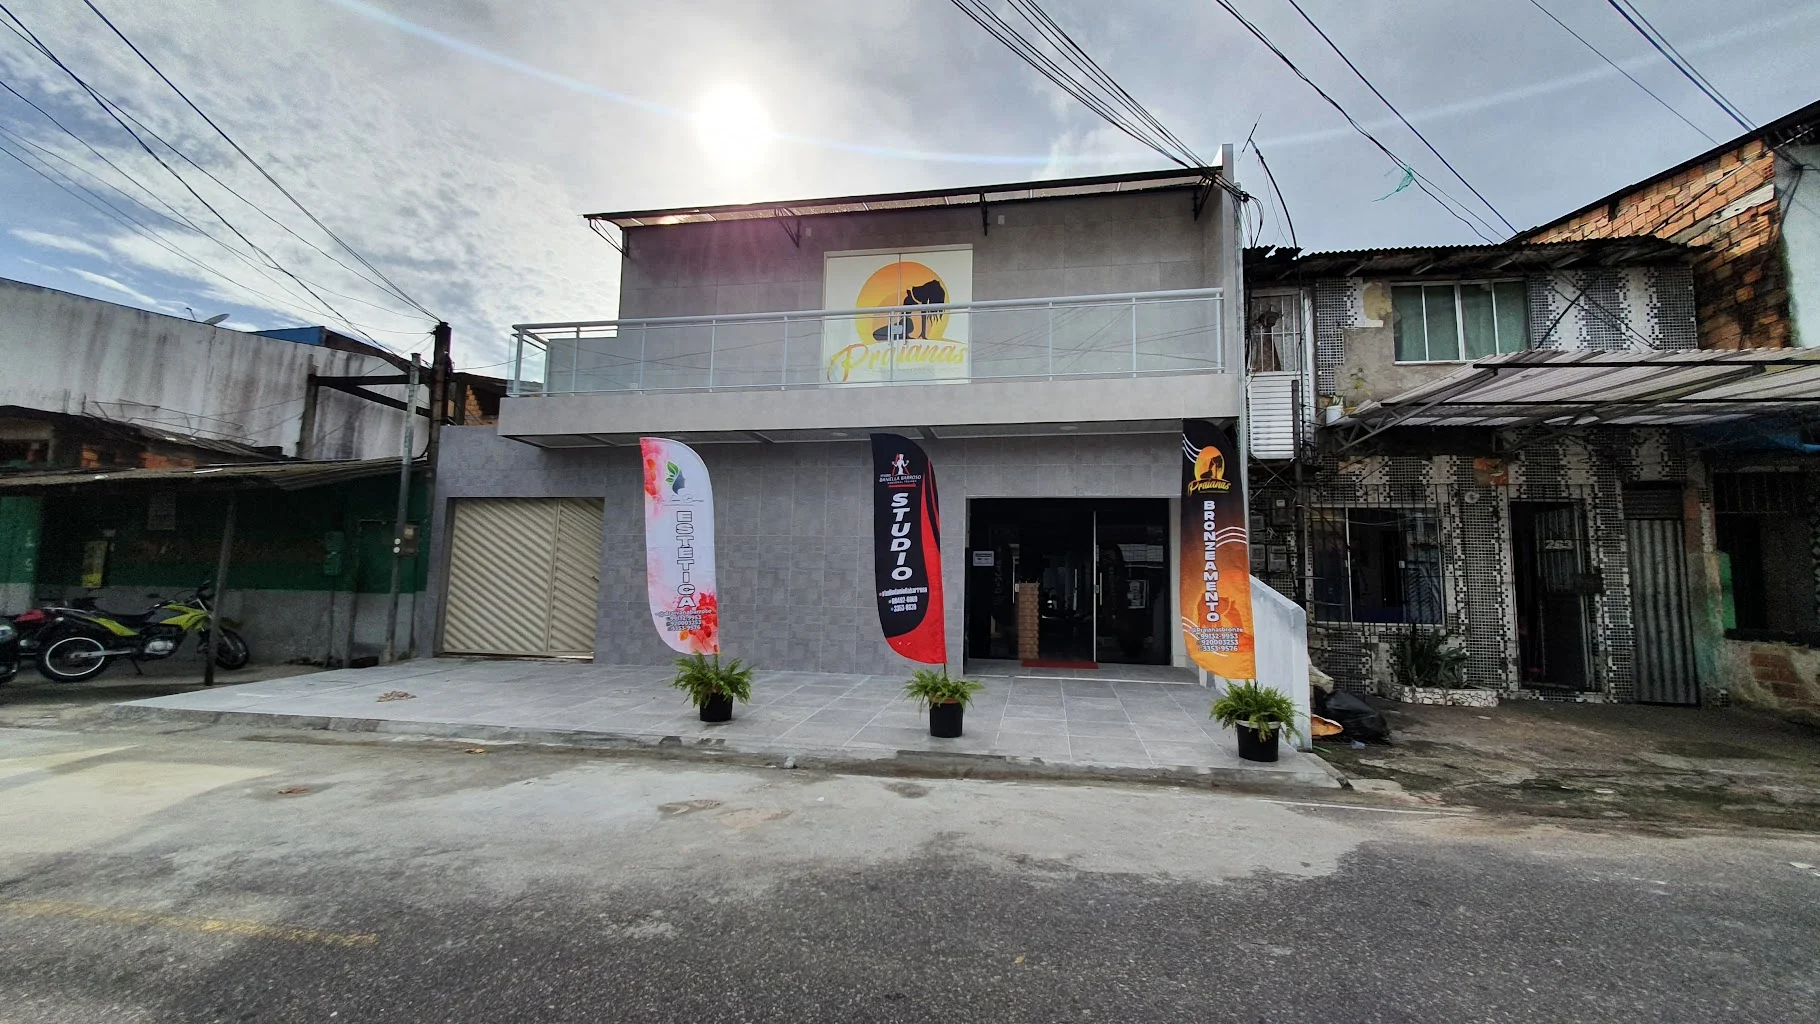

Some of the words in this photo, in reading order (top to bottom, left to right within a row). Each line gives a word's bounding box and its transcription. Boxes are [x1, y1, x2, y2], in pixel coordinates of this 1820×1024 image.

[827, 343, 968, 382] Praianas
[1187, 480, 1231, 497] Praianas
[675, 510, 697, 608] ESTETICA
[889, 492, 913, 580] STUDIO
[1203, 500, 1220, 622] BRONZEAMENTO
